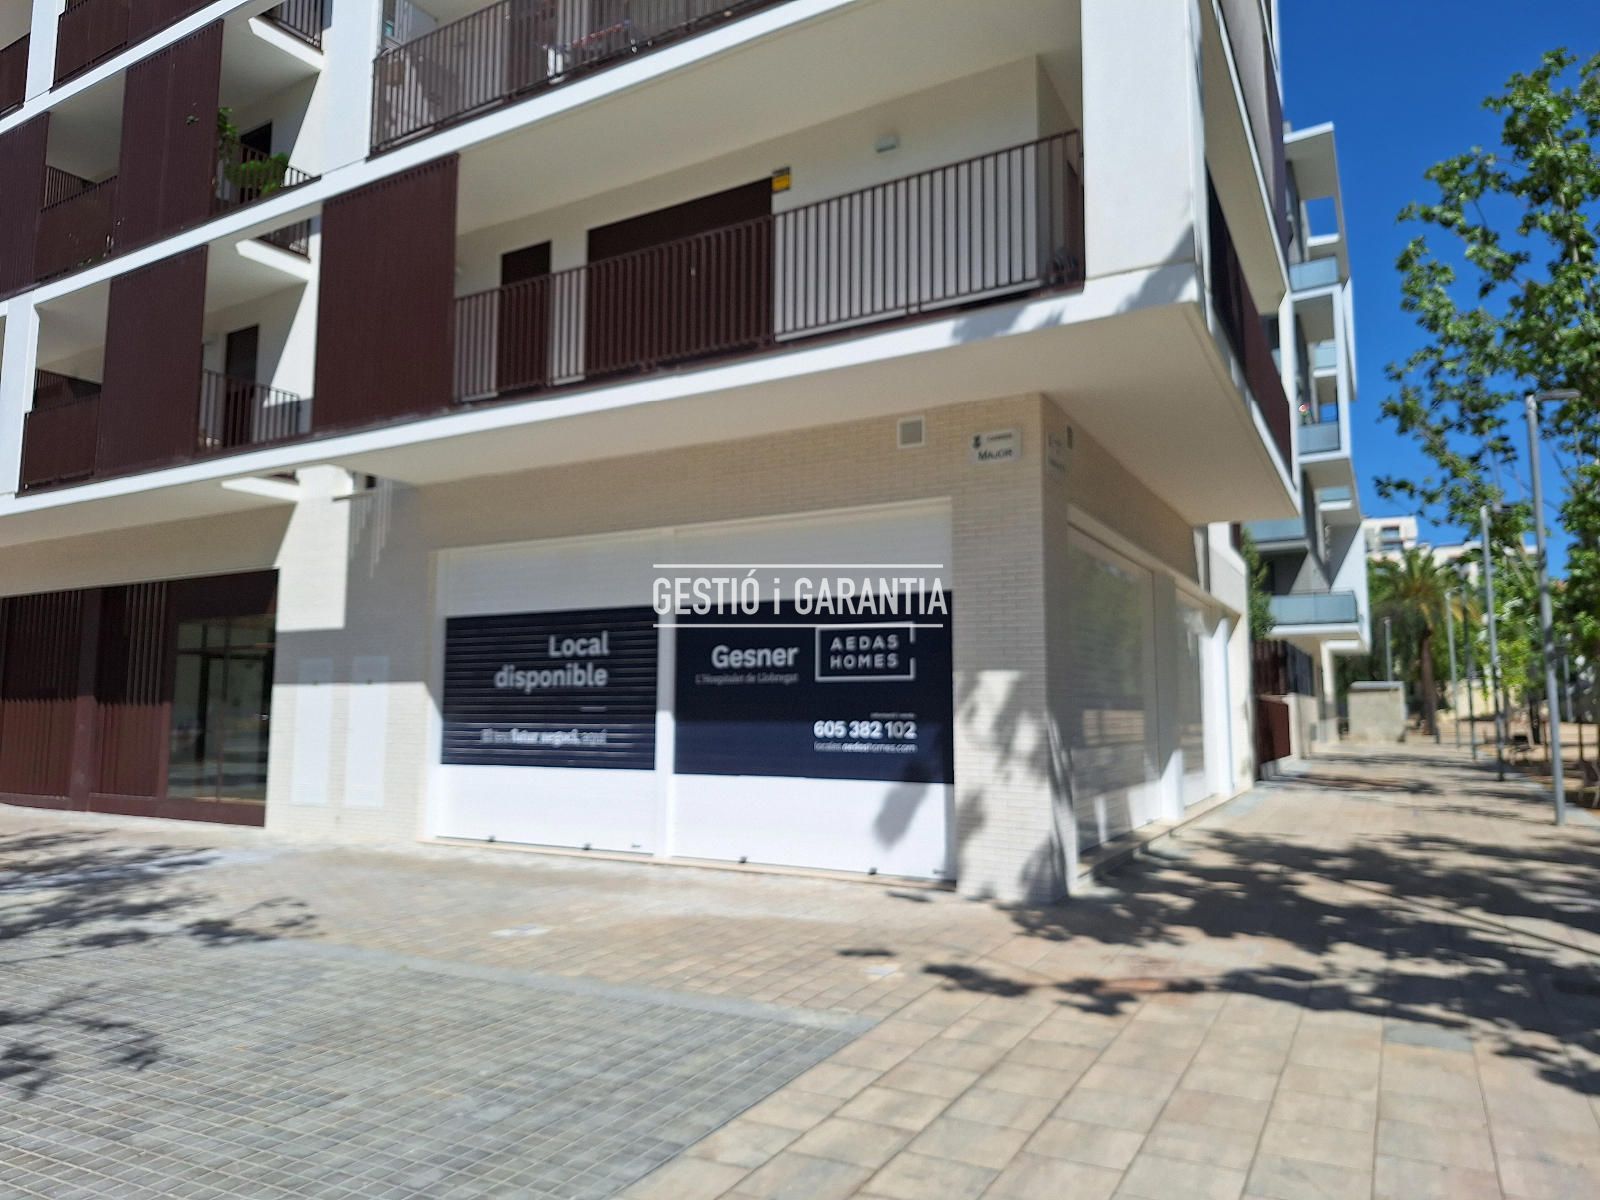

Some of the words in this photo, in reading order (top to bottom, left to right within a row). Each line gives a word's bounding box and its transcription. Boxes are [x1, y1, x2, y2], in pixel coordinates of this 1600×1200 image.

[978, 449, 1013, 461] MAJOR
[548, 631, 609, 657] Local
[830, 634, 900, 652] AEDAS
[711, 644, 800, 670] Gesner
[830, 653, 900, 671] HOMES
[494, 662, 608, 694] disponible
[813, 720, 847, 739] 605
[848, 720, 883, 739] 382
[884, 721, 918, 740] 102
